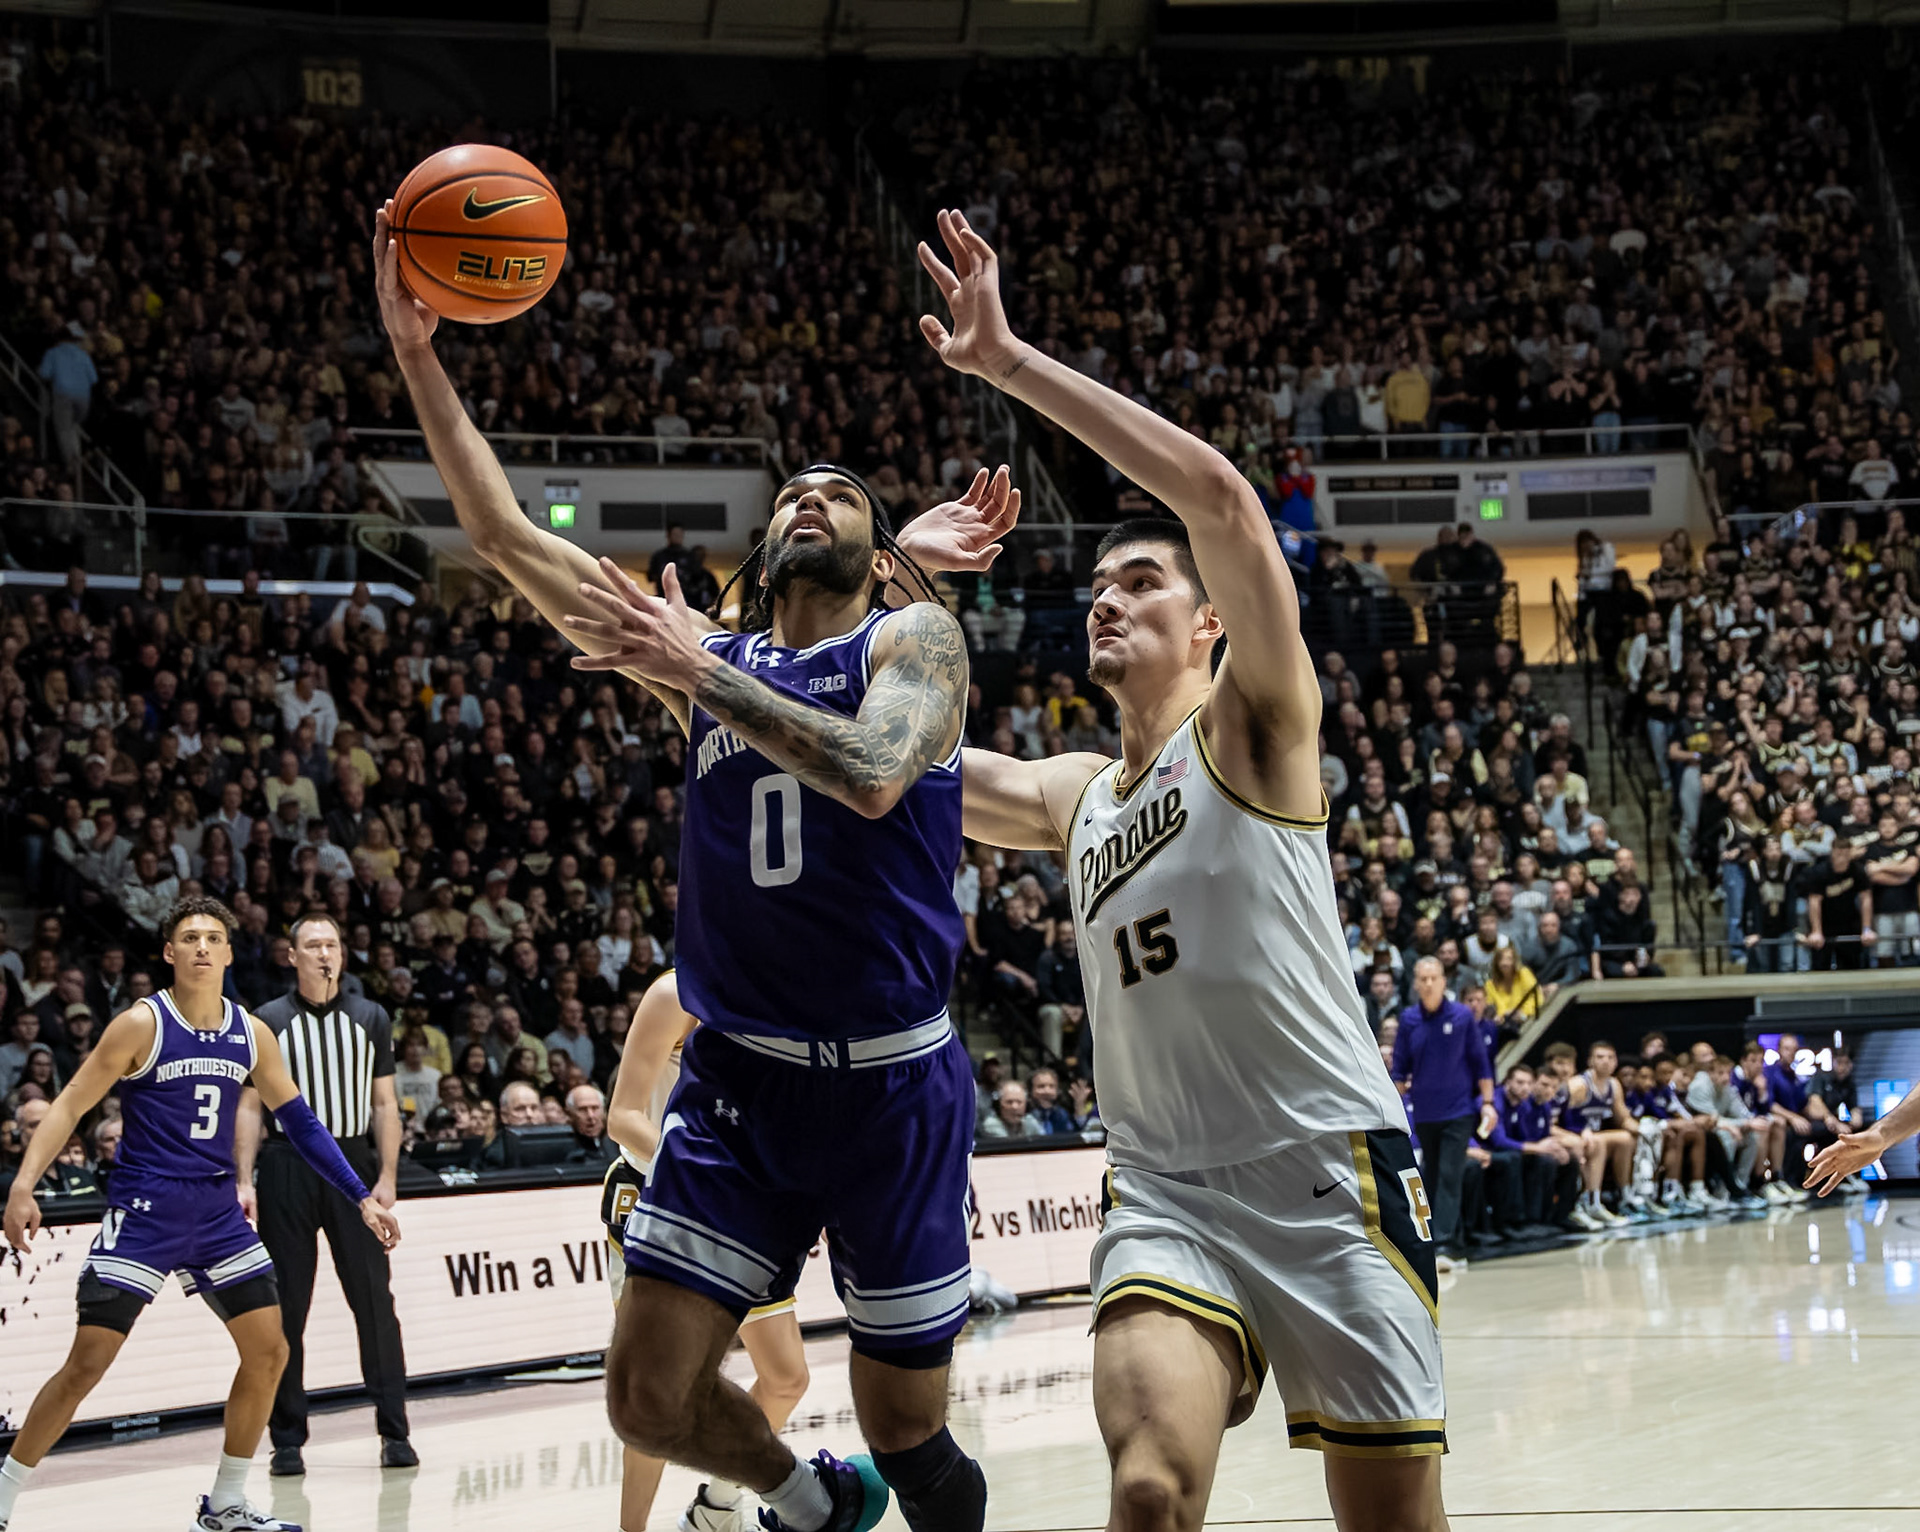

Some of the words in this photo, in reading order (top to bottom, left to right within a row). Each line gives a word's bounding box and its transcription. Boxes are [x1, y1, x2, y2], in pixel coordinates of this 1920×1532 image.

[303, 69, 363, 107] 103
[457, 250, 547, 282] ELITE
[750, 773, 802, 888] 0
[1079, 786, 1189, 922] Purdue
[1113, 907, 1180, 990] 15
[817, 1041, 839, 1068] N
[189, 1084, 221, 1140] 3
[444, 1251, 520, 1298] Win
[532, 1257, 555, 1289] a
[562, 1240, 609, 1284] VI
[991, 1211, 1021, 1238] vs
